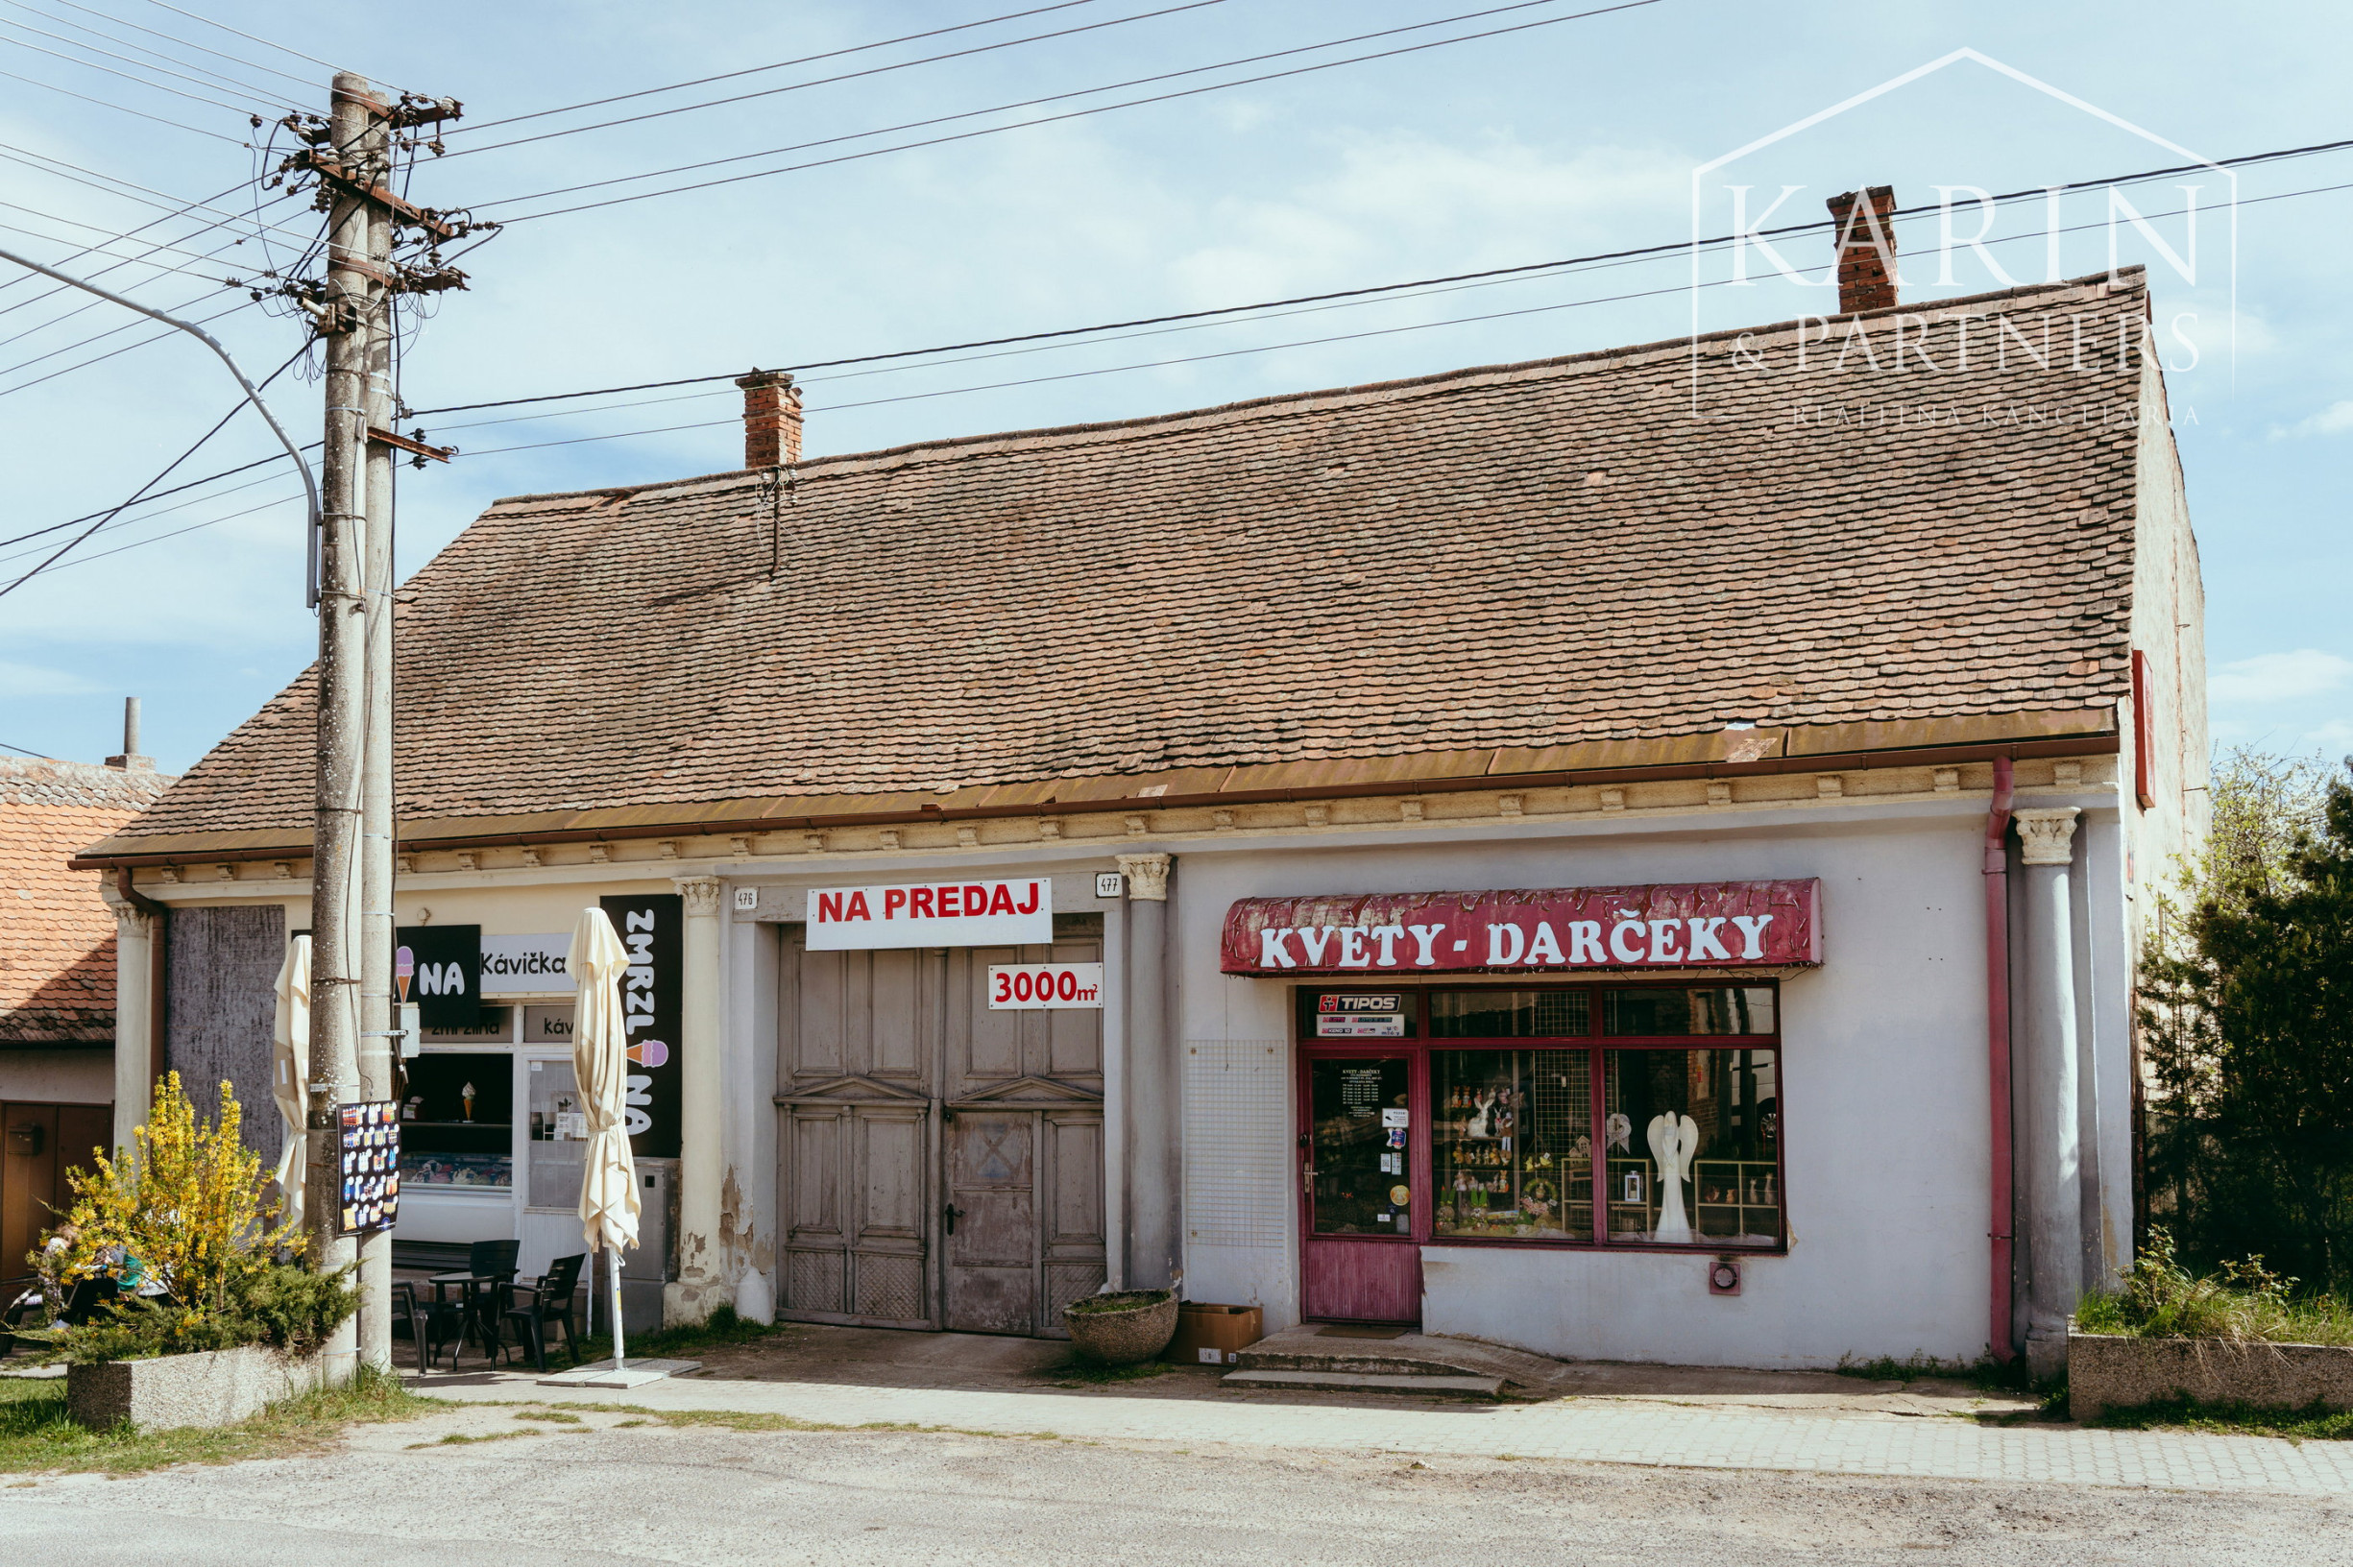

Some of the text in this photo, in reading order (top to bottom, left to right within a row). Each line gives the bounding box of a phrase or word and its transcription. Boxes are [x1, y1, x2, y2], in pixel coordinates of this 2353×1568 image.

[738, 892, 754, 906] 476
[1101, 878, 1118, 892] 477
[818, 882, 1040, 923] NA PREDAJ
[1260, 924, 1445, 969] KVETY
[1486, 908, 1774, 965] DARČEKY
[419, 961, 465, 996] NA
[481, 952, 567, 976] Kávička
[626, 909, 655, 1035] ZMRZL
[1342, 997, 1396, 1010] TIPOS
[544, 1017, 574, 1035] káv
[625, 1074, 652, 1135] NA
